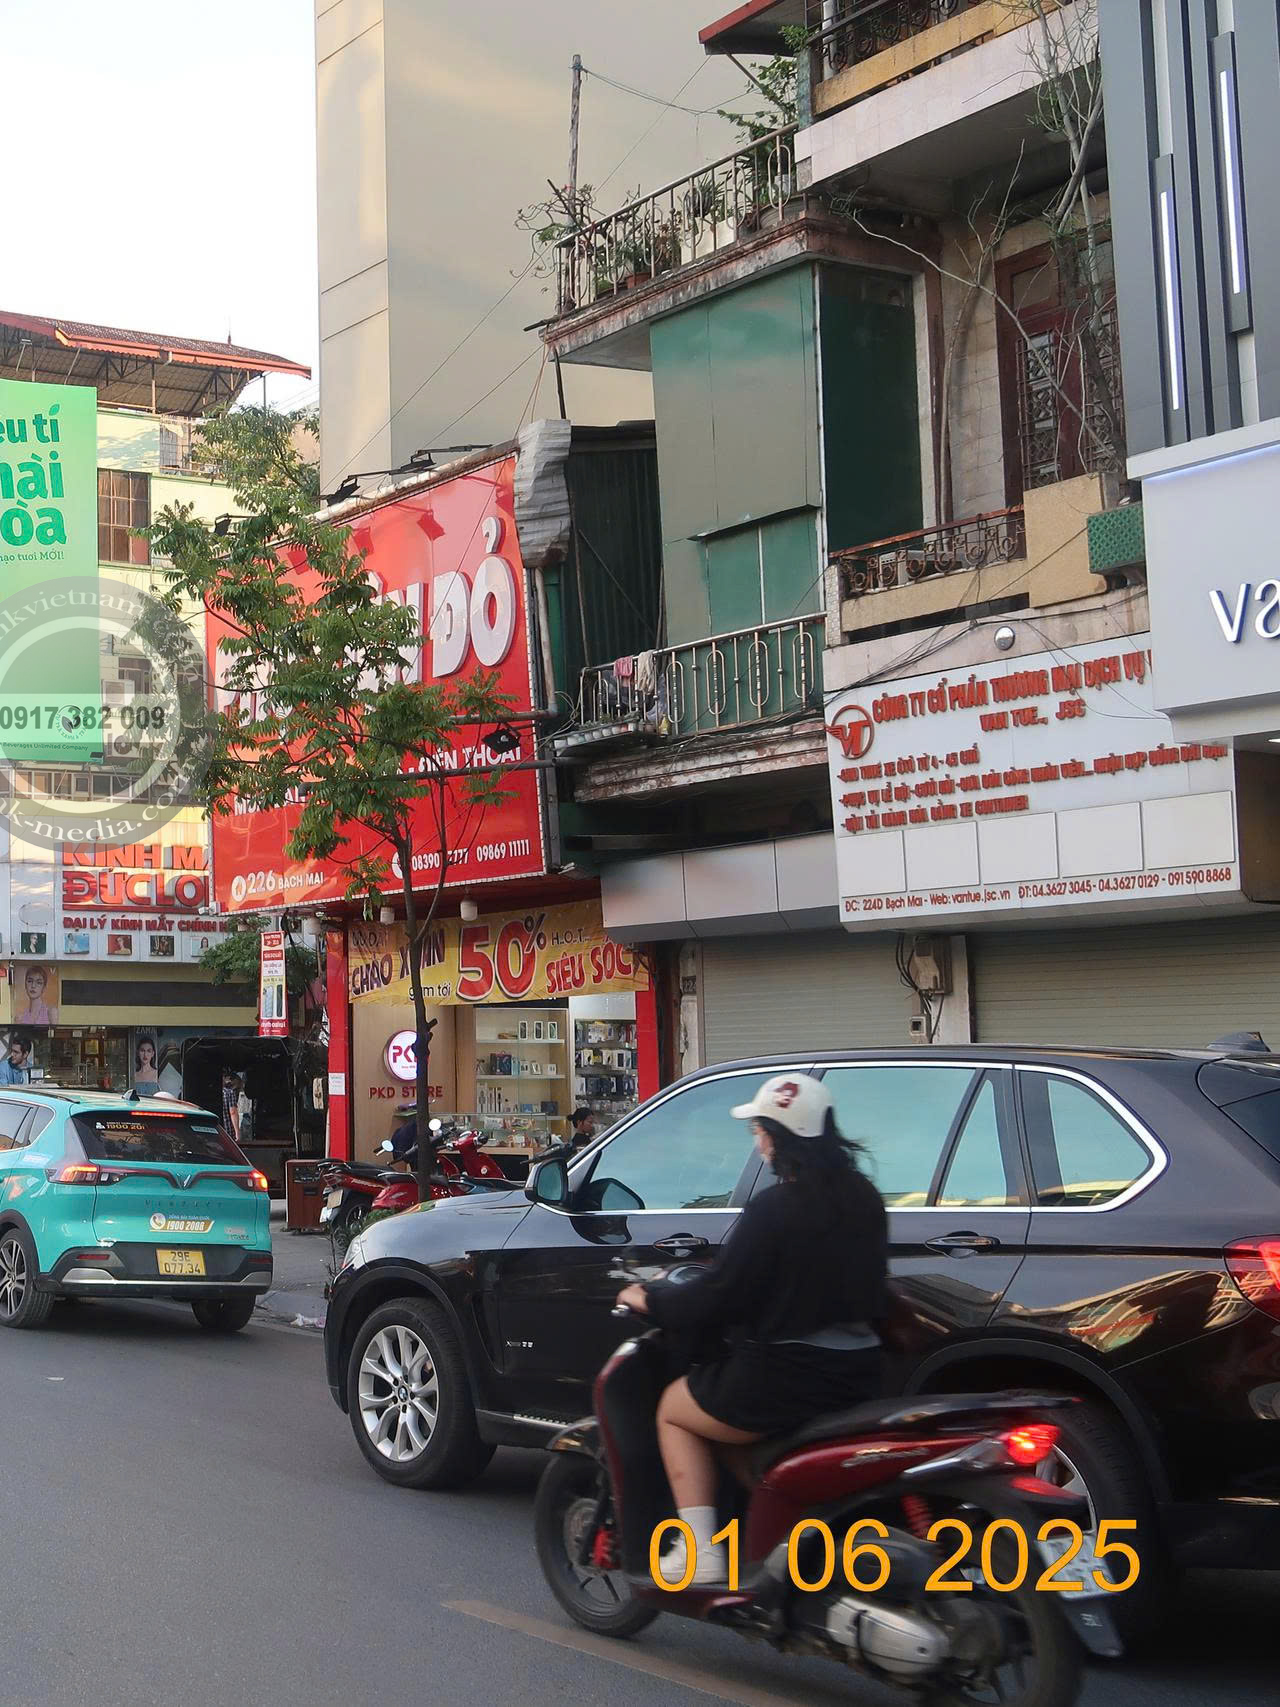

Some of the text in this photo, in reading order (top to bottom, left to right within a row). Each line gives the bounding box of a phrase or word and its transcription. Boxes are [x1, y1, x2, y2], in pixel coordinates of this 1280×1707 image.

[33, 404, 60, 443] tí
[40, 550, 64, 561] MỚI!
[431, 516, 516, 678] ĐỎ
[909, 691, 925, 717] TY
[948, 673, 989, 711] PHẦN
[1083, 655, 1122, 691] DỊCH
[1122, 650, 1145, 685] VỤ
[1055, 698, 1086, 720] JSC
[63, 837, 209, 870] KÍNH M
[412, 839, 529, 871] 08390 09869 11111
[247, 870, 324, 894] 226 MAI
[845, 900, 860, 912] ĐC:
[862, 898, 883, 910] 224D
[886, 896, 905, 912] Bạch
[907, 895, 923, 907] Mai
[930, 893, 951, 905] Web:
[1206, 867, 1232, 883] 8868
[63, 916, 87, 931] ĐẠI
[89, 914, 107, 930] LÝ
[111, 915, 142, 931] KÍNH
[145, 914, 175, 931] MẮT
[177, 917, 217, 932] CHÍNH
[457, 913, 546, 1000] 50%
[546, 951, 584, 993] SIÊU
[352, 951, 393, 995] CHÀO
[438, 983, 451, 996] tới
[370, 1085, 443, 1099] PKD STRE
[164, 1262, 200, 1273] 077.34
